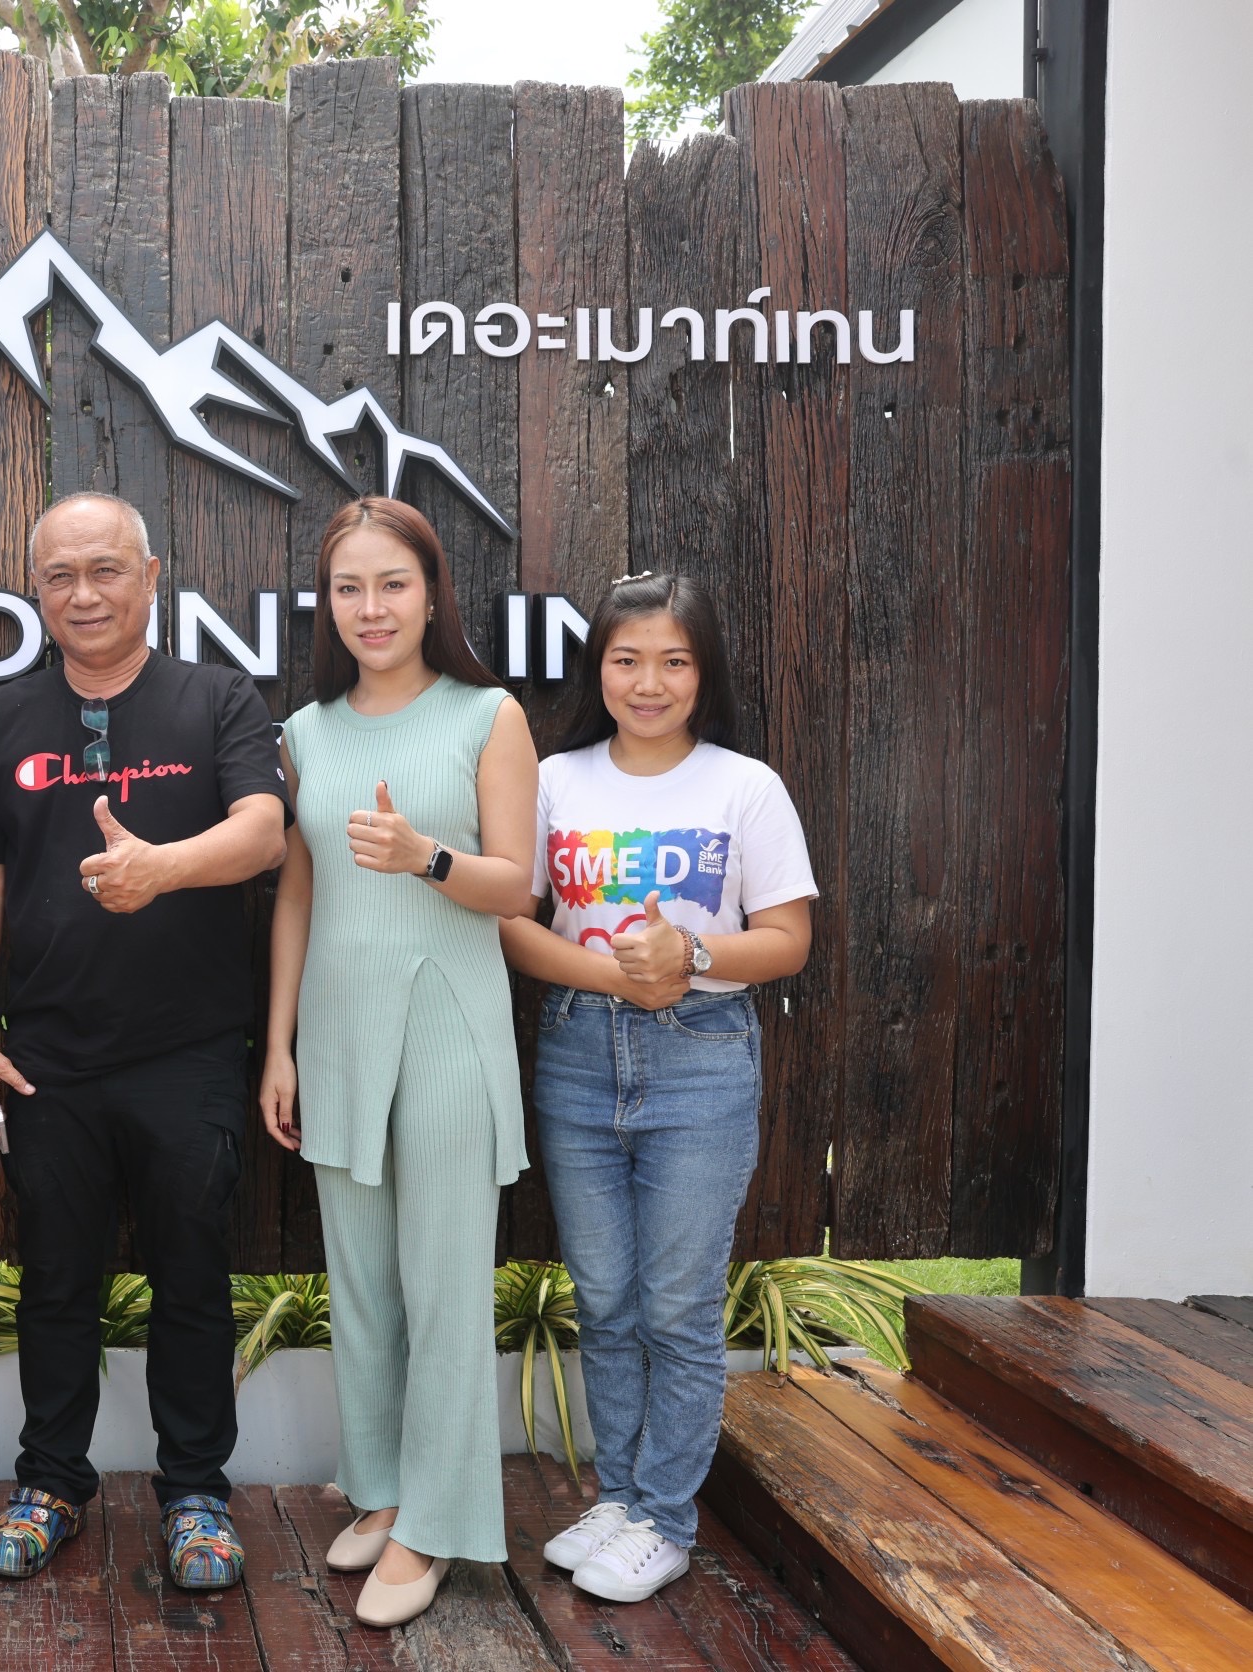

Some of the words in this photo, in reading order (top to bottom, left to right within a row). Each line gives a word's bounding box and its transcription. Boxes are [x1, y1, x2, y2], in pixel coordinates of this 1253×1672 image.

[387, 286, 915, 364] เดอะเมาท์เทน
[553, 846, 642, 886] SME
[655, 845, 690, 885] D
[698, 863, 723, 875] Bank
[699, 850, 724, 863] SME
